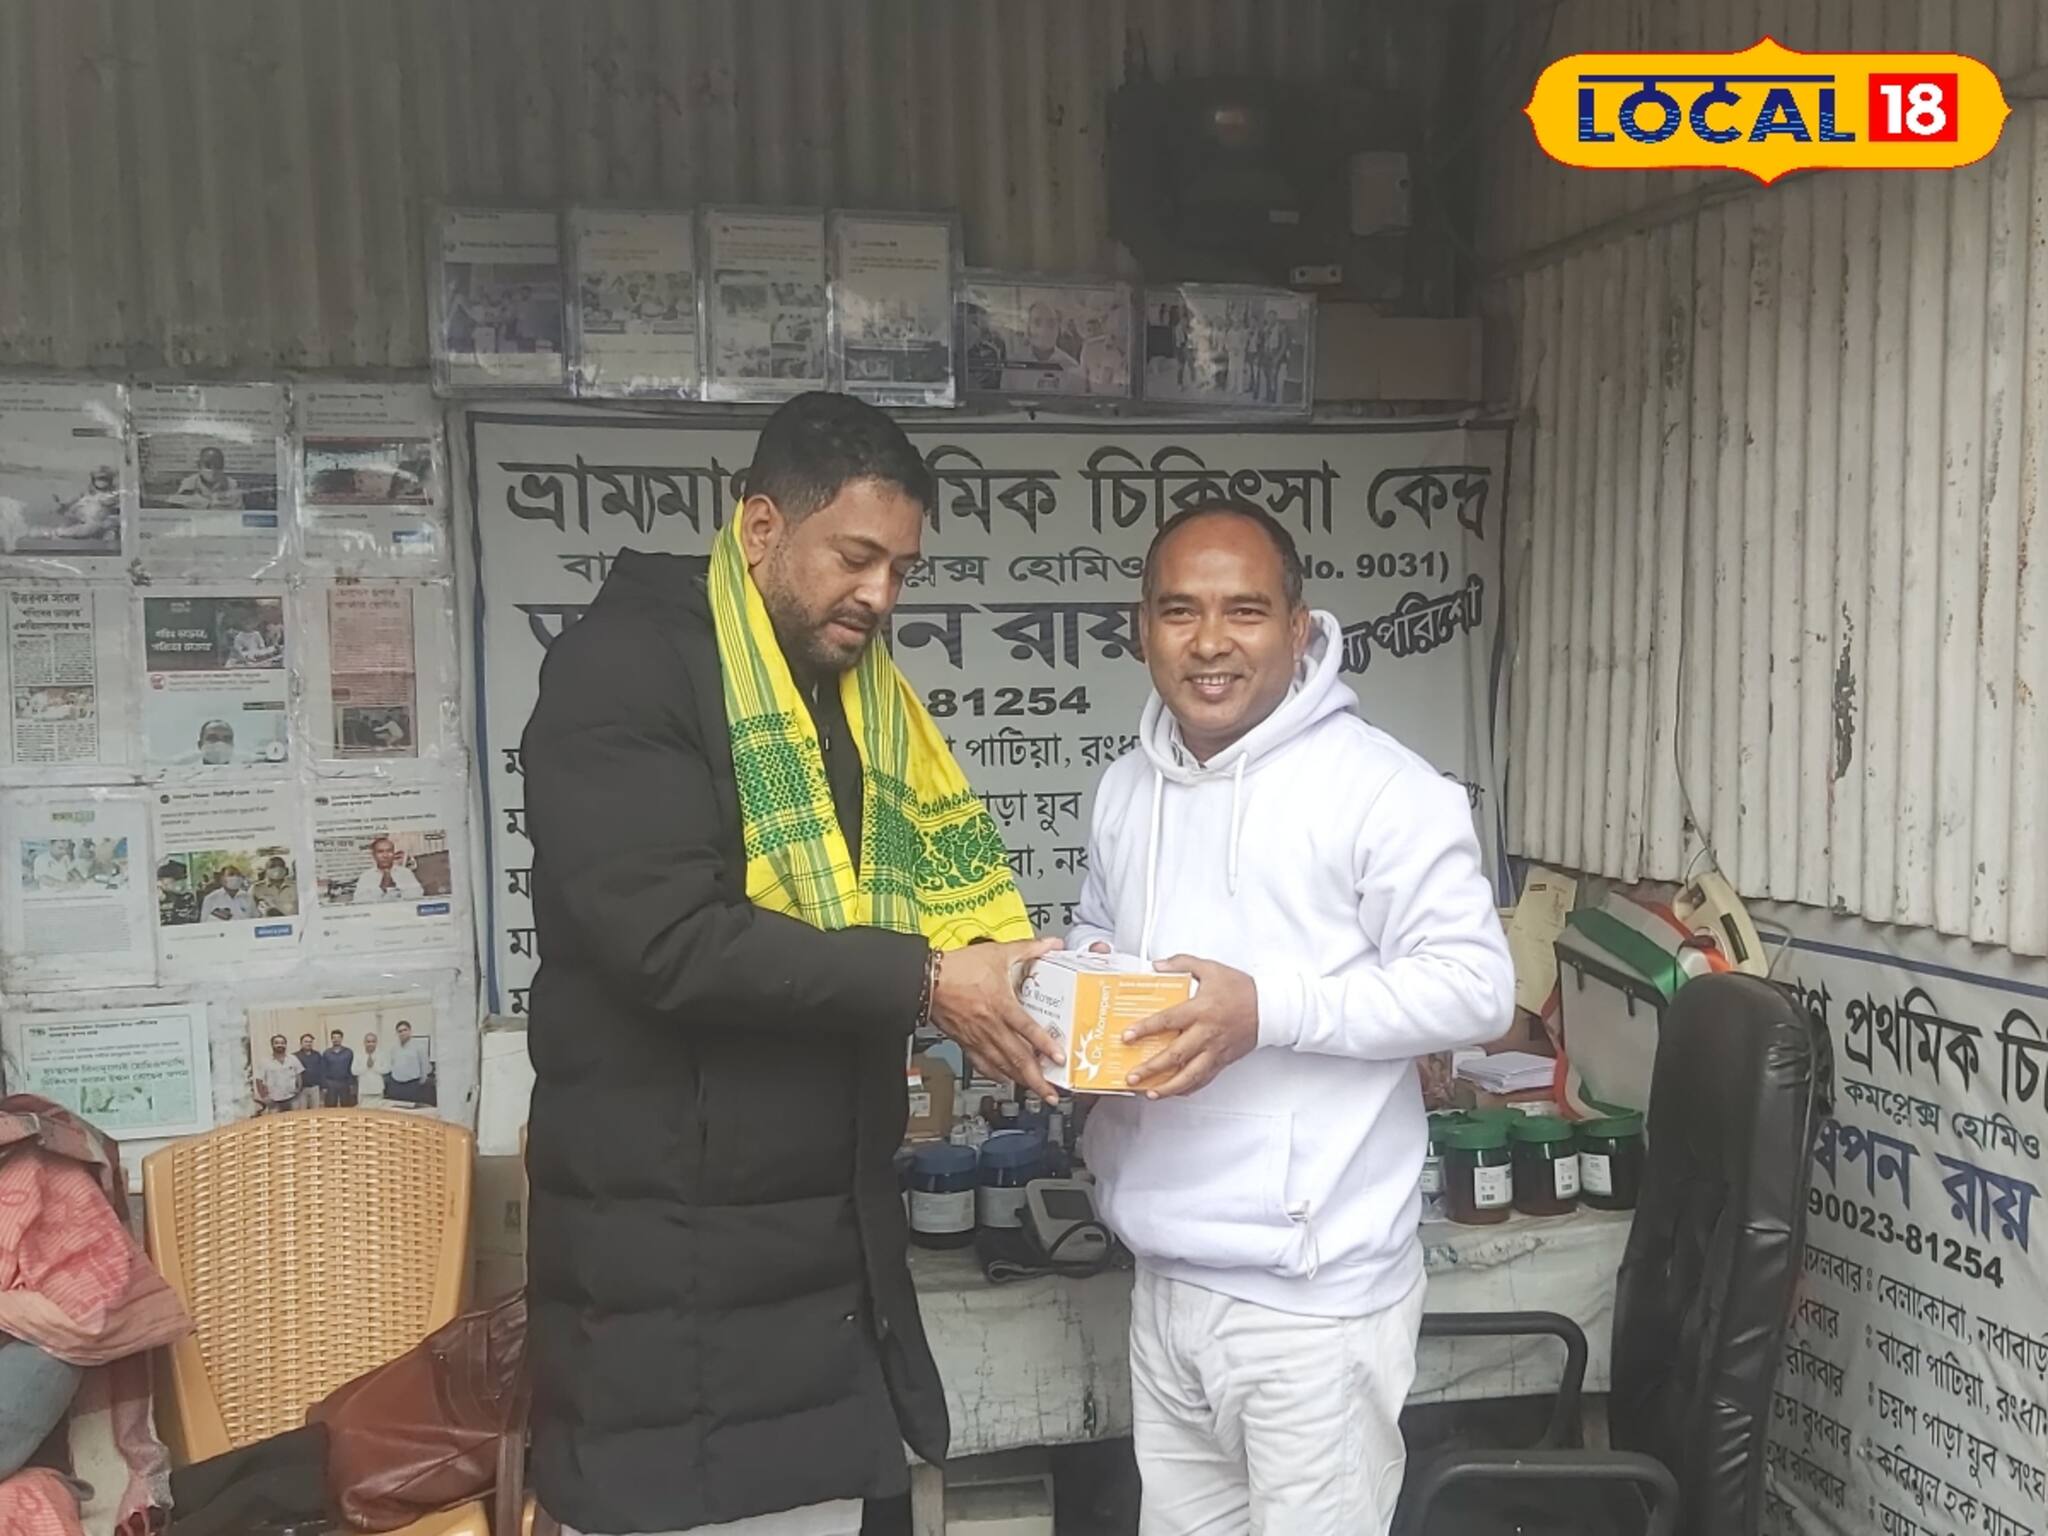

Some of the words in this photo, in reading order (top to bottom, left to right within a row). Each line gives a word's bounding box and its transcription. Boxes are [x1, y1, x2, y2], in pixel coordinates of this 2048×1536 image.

[497, 453, 748, 535] ভ্রাম্যমা
[1367, 465, 1492, 541] কেন্দ্র
[1356, 551, 1449, 583] 9031)
[1034, 792, 1083, 837] যুব
[1952, 1112, 2041, 1160] হোমিও
[1808, 1187, 2004, 1289] 90023-81254
[1935, 1151, 2042, 1254] রায়
[1786, 1340, 1844, 1397] রবিবার
[1922, 1411, 1963, 1459] পাড়া
[1967, 1432, 1998, 1488] যুব
